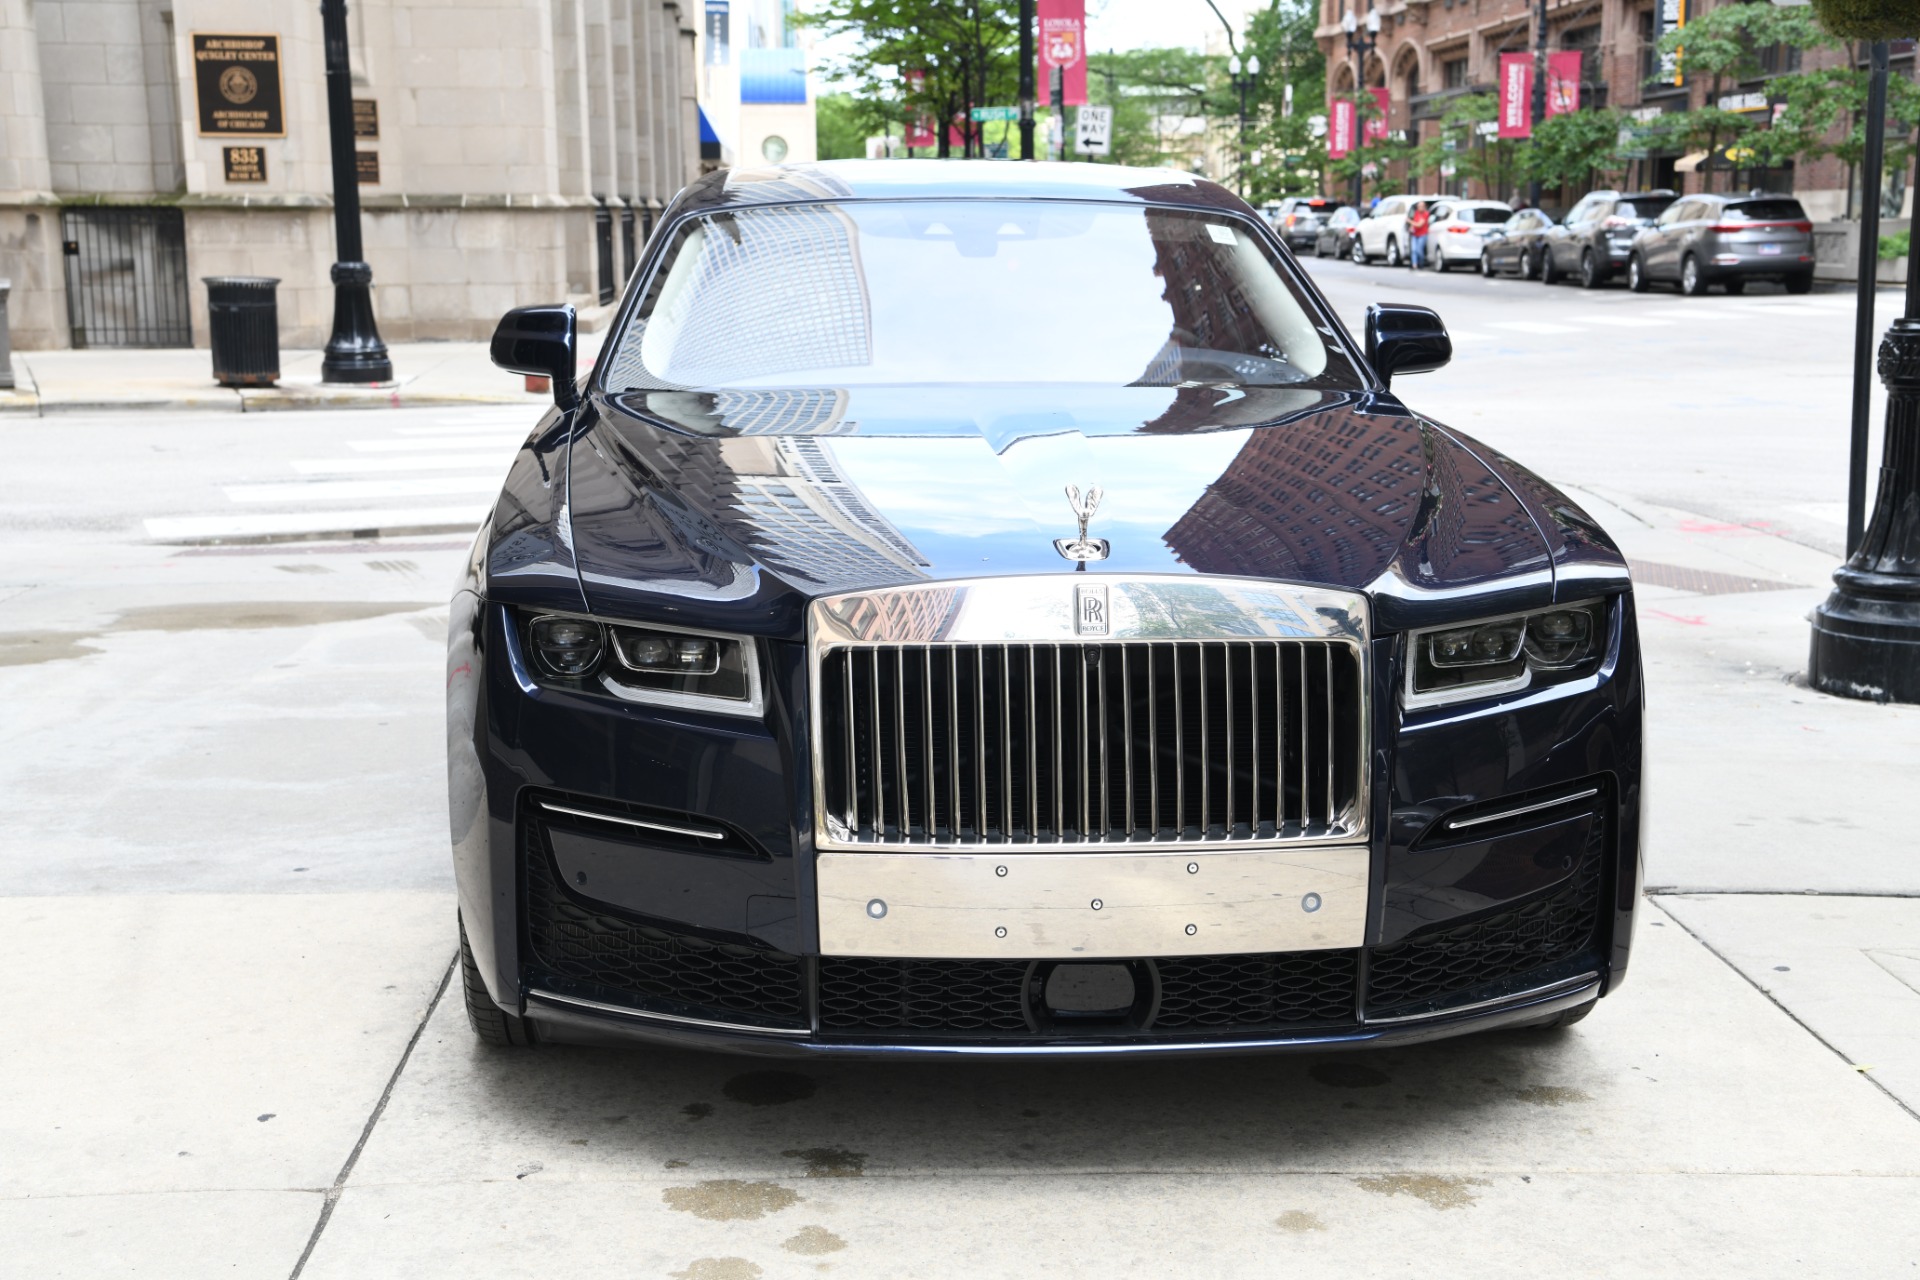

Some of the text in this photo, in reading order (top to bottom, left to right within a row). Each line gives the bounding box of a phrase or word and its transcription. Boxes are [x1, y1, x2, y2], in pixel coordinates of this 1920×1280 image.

[1043, 18, 1080, 27] LOYOLA
[238, 51, 275, 61] CENTER
[1506, 63, 1519, 127] WELCOME
[1082, 110, 1106, 121] ONE
[229, 120, 266, 129] CHICAGO
[1081, 124, 1106, 134] WAY
[230, 148, 259, 164] 835
